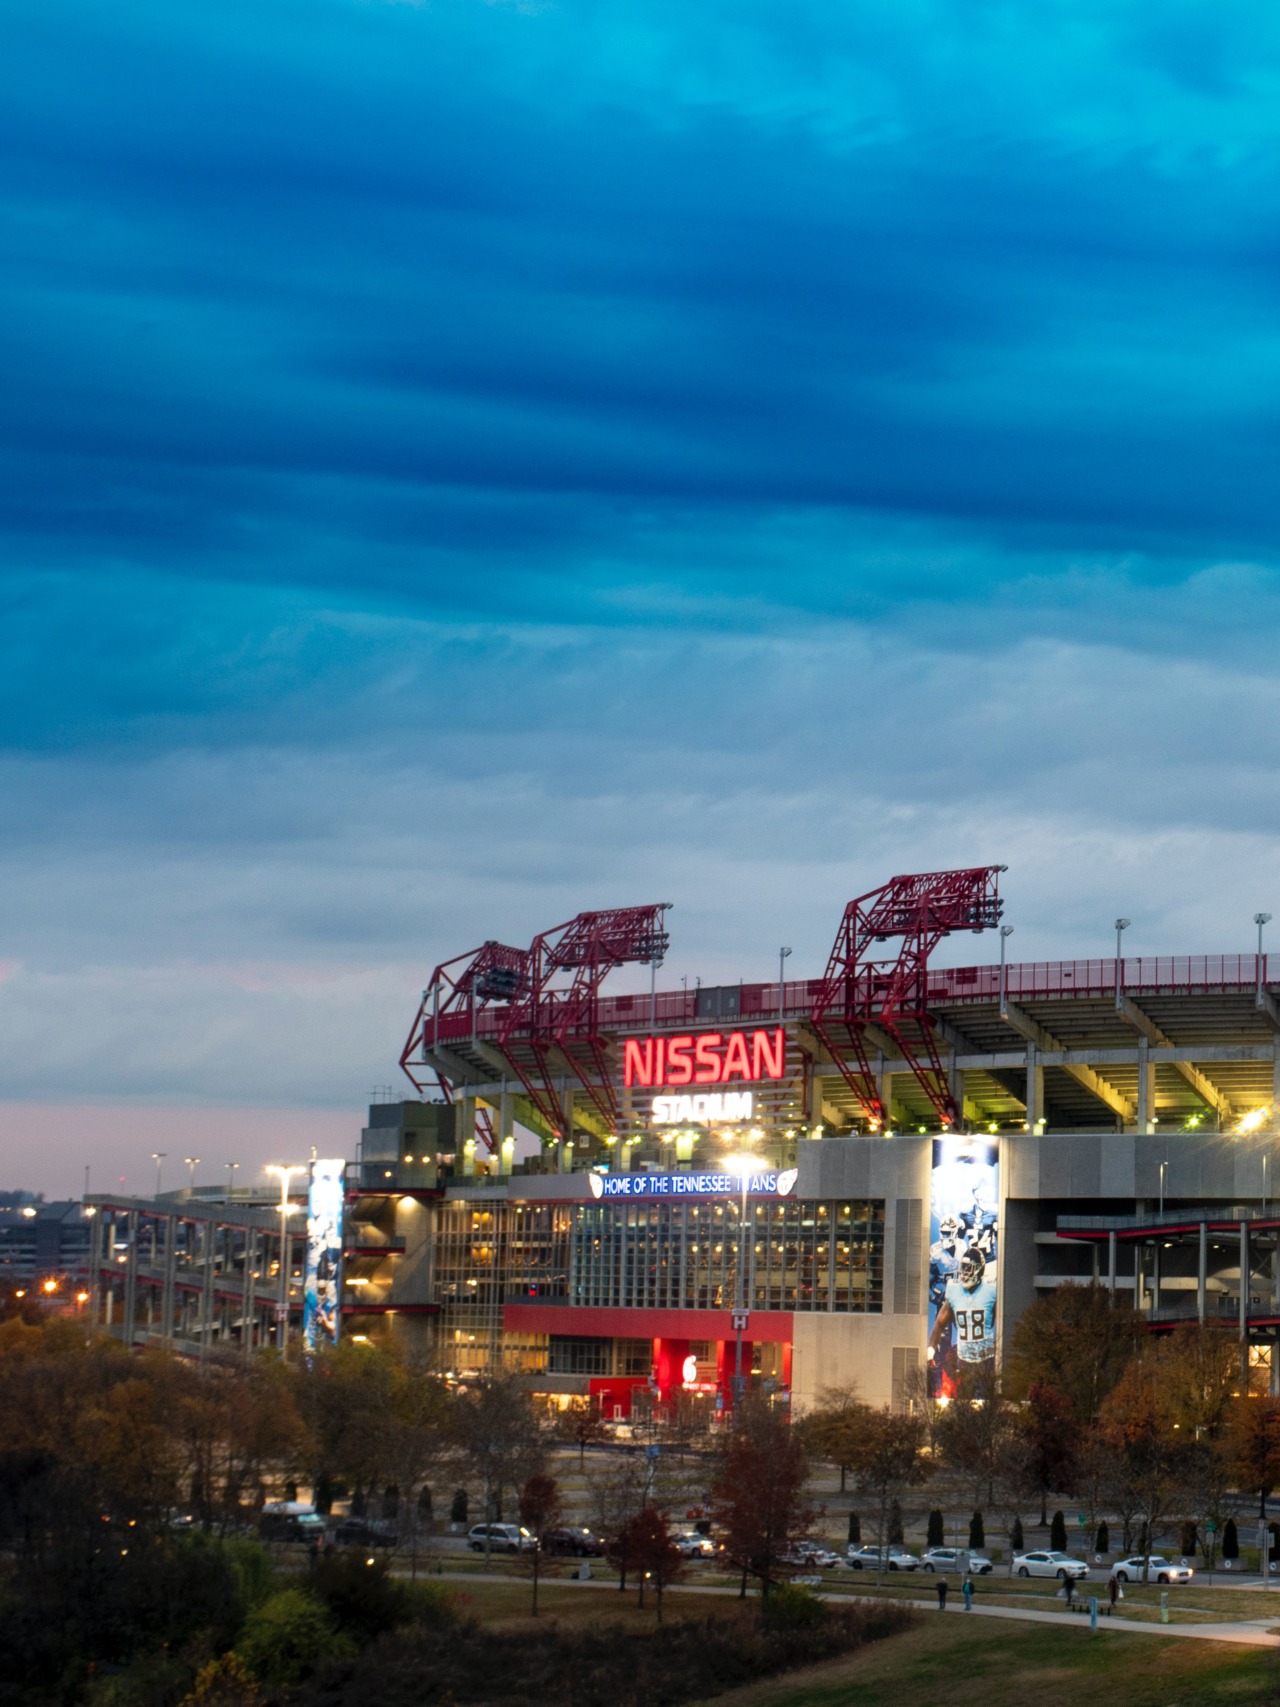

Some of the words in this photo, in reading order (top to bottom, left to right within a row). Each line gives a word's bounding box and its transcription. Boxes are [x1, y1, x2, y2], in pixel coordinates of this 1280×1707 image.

[624, 1029, 784, 1087] NISSAN
[652, 1092, 752, 1123] STADIUM
[604, 1177, 631, 1194] HOME
[633, 1177, 647, 1193] OF
[650, 1176, 669, 1192] THE
[672, 1175, 732, 1192] TENNESSEE
[735, 1174, 777, 1191] TTANS
[733, 1316, 746, 1329] H
[956, 1310, 986, 1341] 98
